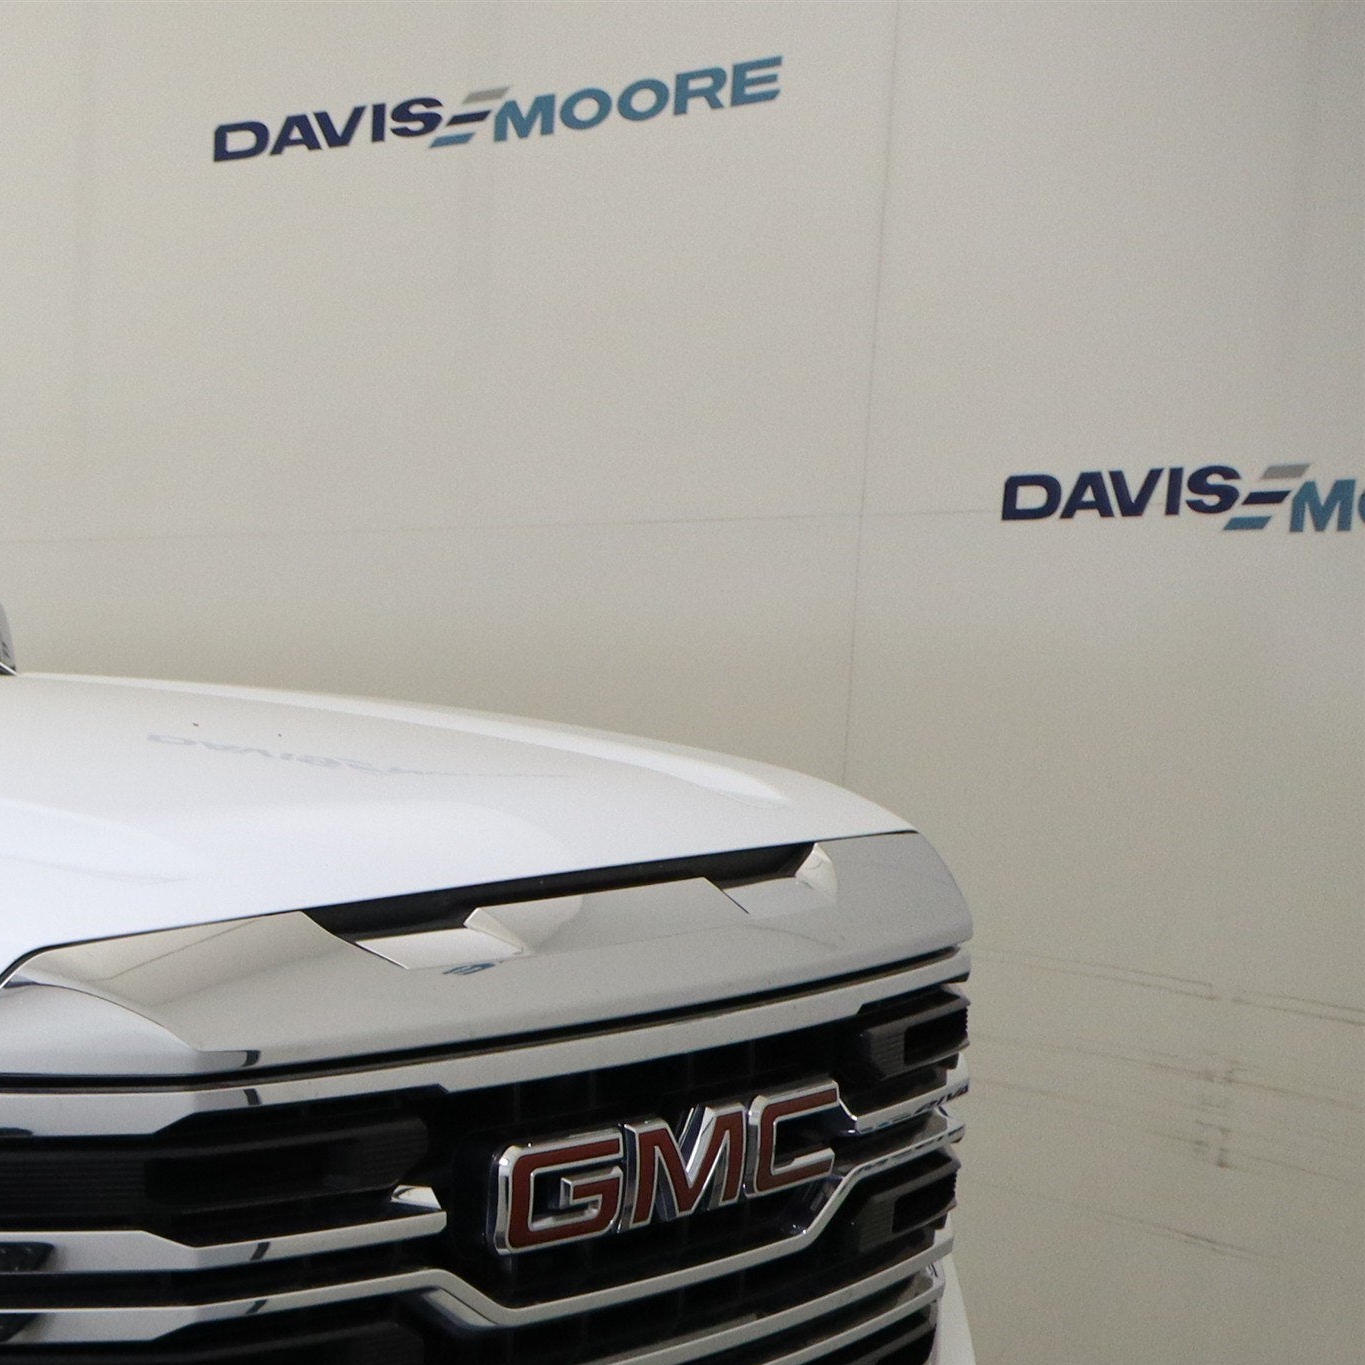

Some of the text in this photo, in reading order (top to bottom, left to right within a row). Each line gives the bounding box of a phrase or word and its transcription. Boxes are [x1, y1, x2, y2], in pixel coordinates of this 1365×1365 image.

[212, 56, 783, 162] DAVIS MOORE
[1001, 465, 1365, 532] DAVIS M
[489, 1078, 841, 1256] GMC
